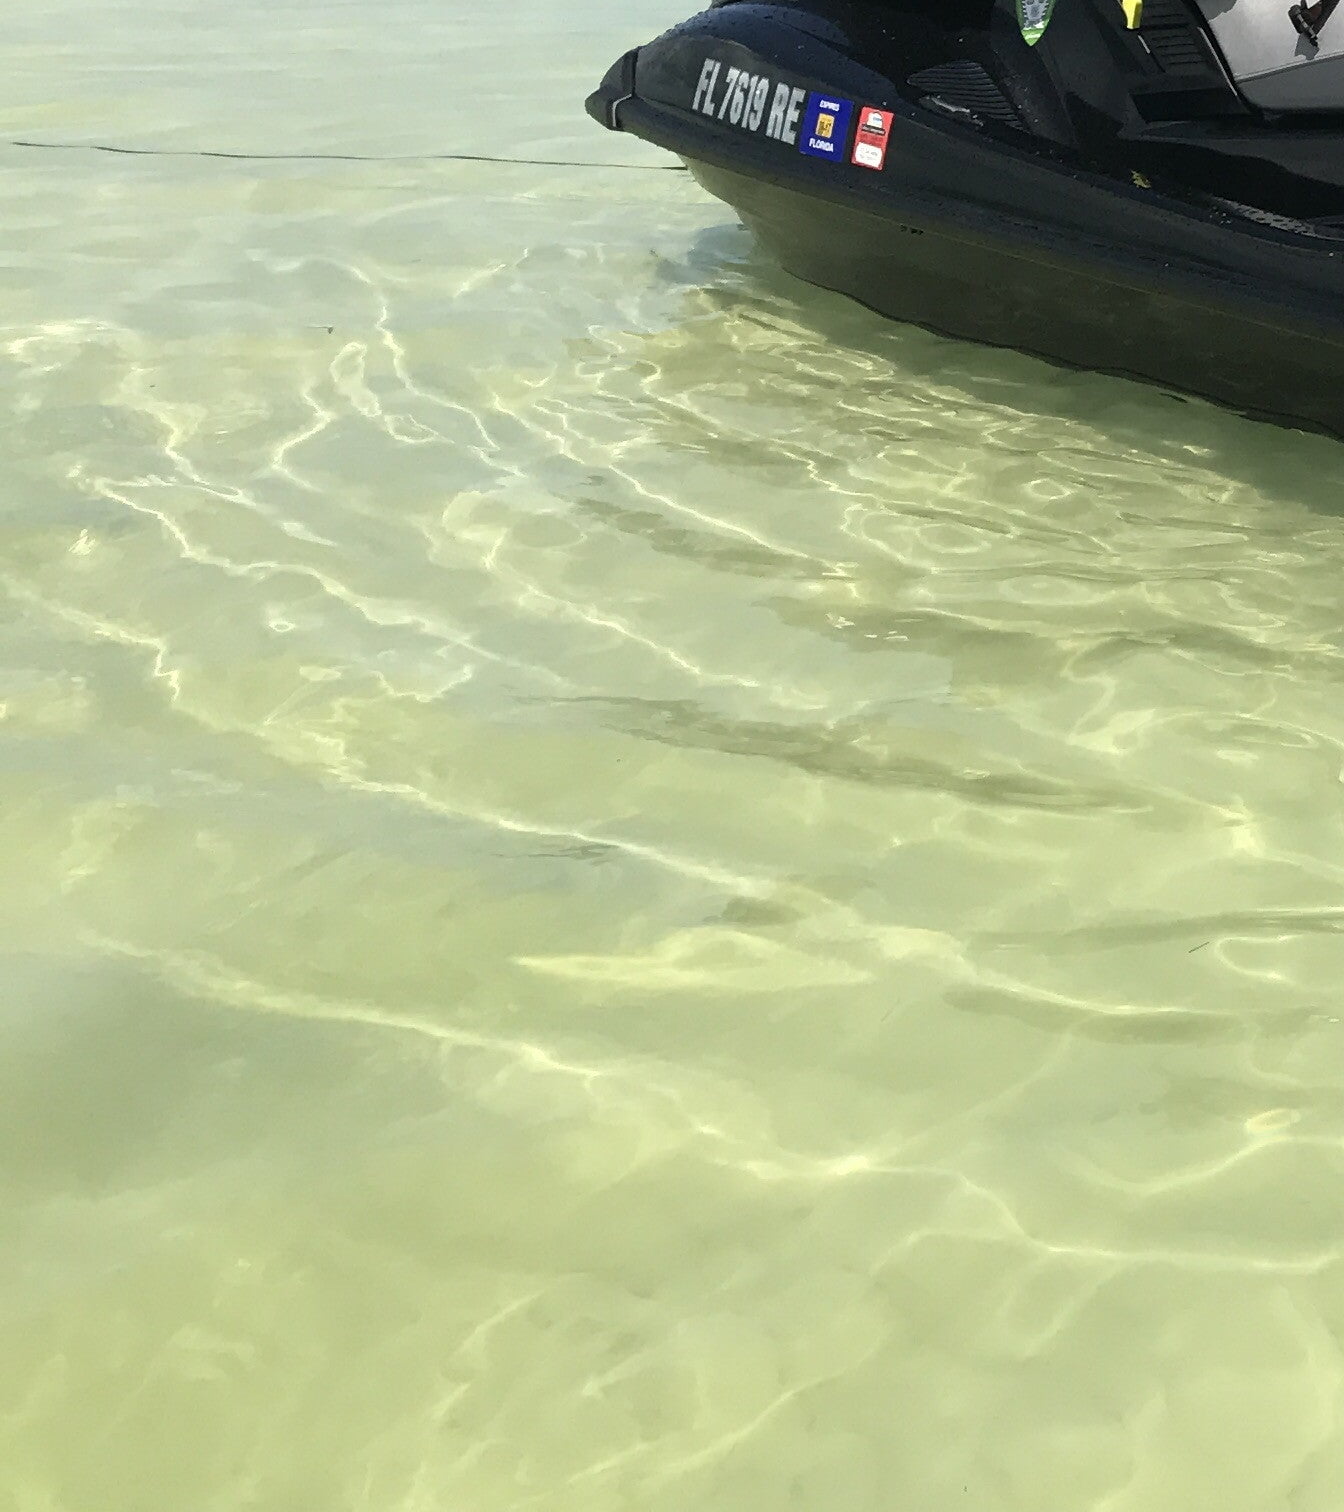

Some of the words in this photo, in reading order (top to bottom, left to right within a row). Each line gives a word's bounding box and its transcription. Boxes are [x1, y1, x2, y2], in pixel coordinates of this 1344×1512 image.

[692, 58, 721, 117] FL
[717, 65, 769, 132] 7619
[765, 82, 806, 146] RE
